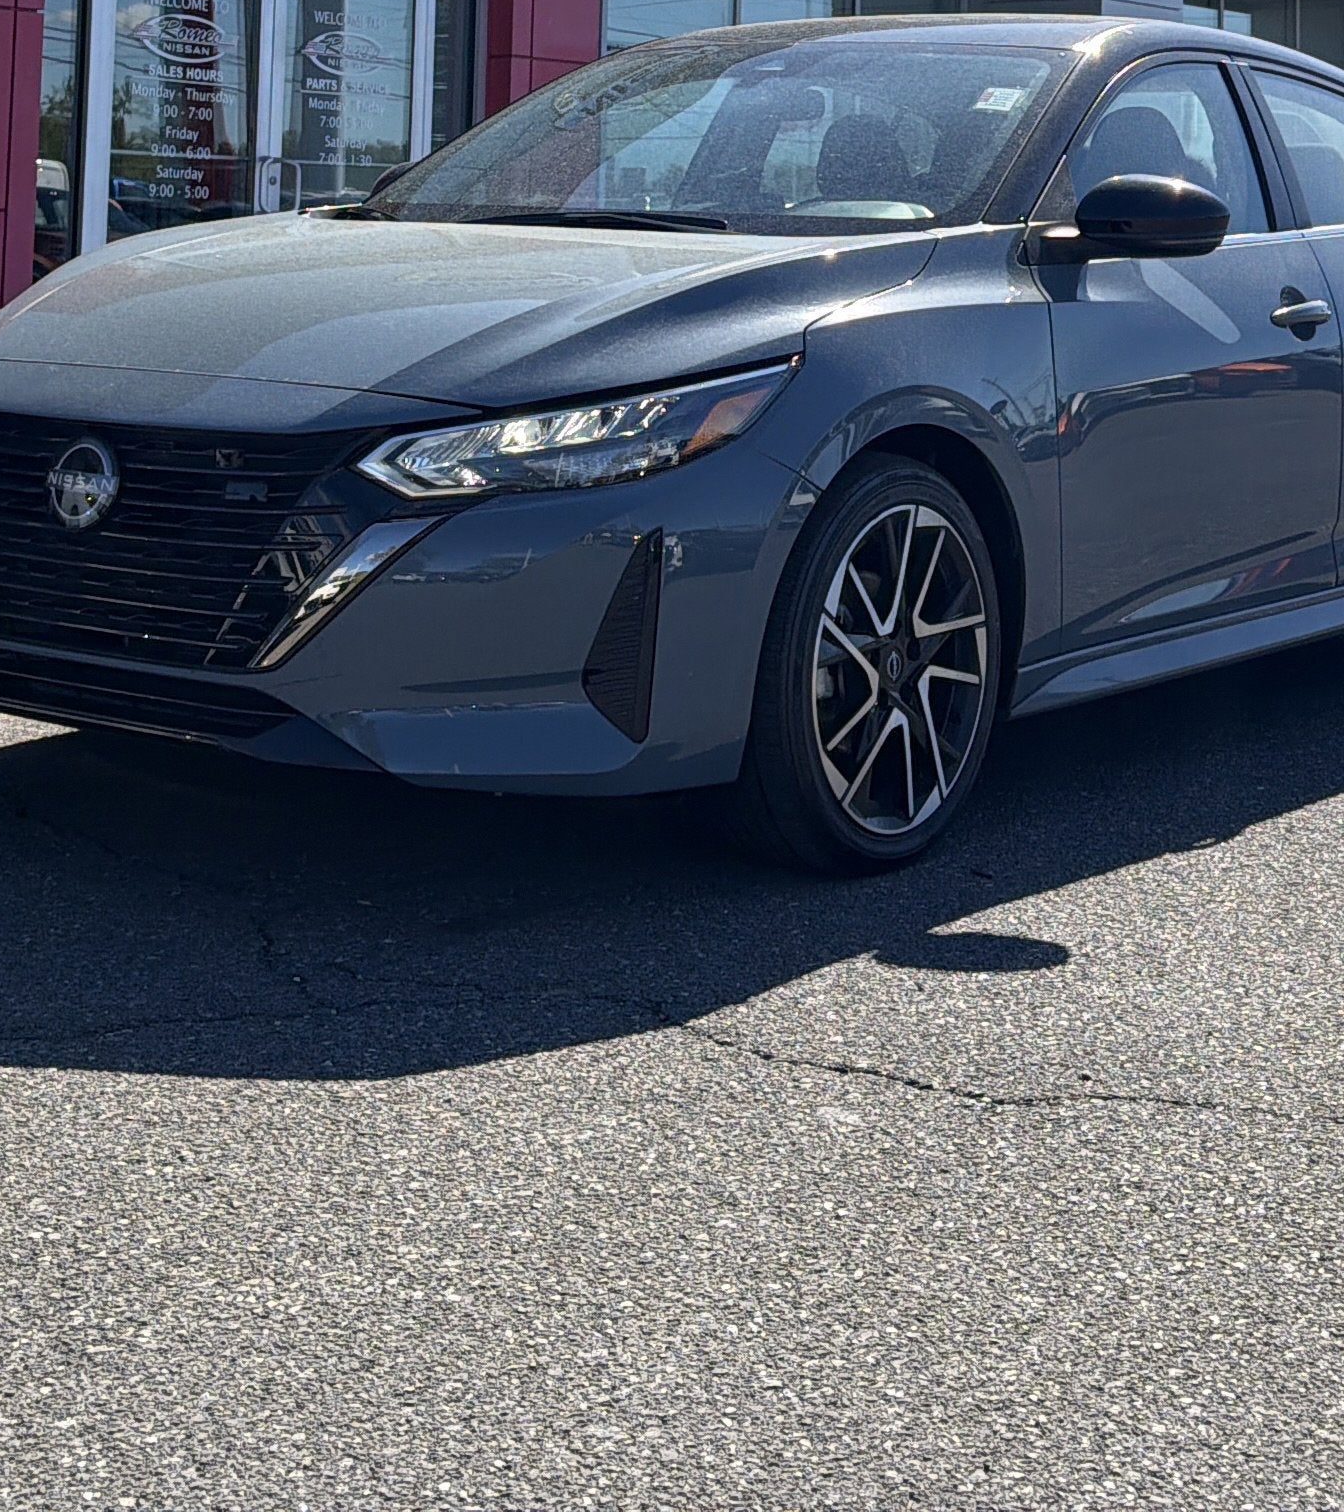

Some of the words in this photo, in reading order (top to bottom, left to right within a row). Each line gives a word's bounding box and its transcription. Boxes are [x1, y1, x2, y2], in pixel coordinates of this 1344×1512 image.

[213, 0, 230, 15] TO
[159, 17, 223, 44] Romeo
[163, 42, 210, 56] NISSAN
[148, 64, 184, 79] SALES
[186, 67, 224, 83] HOURS
[306, 77, 338, 91] PARTS
[131, 82, 177, 101] Monday
[185, 87, 236, 105] Thursday
[153, 104, 178, 118] 9:00
[188, 106, 213, 121] 7:00
[319, 115, 342, 129] 7:00
[165, 125, 200, 142] Friday
[151, 143, 177, 158] 9:00
[186, 145, 211, 160] 6:00
[324, 134, 368, 152] Saturday
[318, 152, 342, 166] 7:00
[350, 154, 373, 167] 1:30
[156, 164, 205, 184] Saturday
[148, 183, 175, 198] 9:00
[184, 185, 210, 200] 5:00
[47, 470, 116, 492] NISSAN
